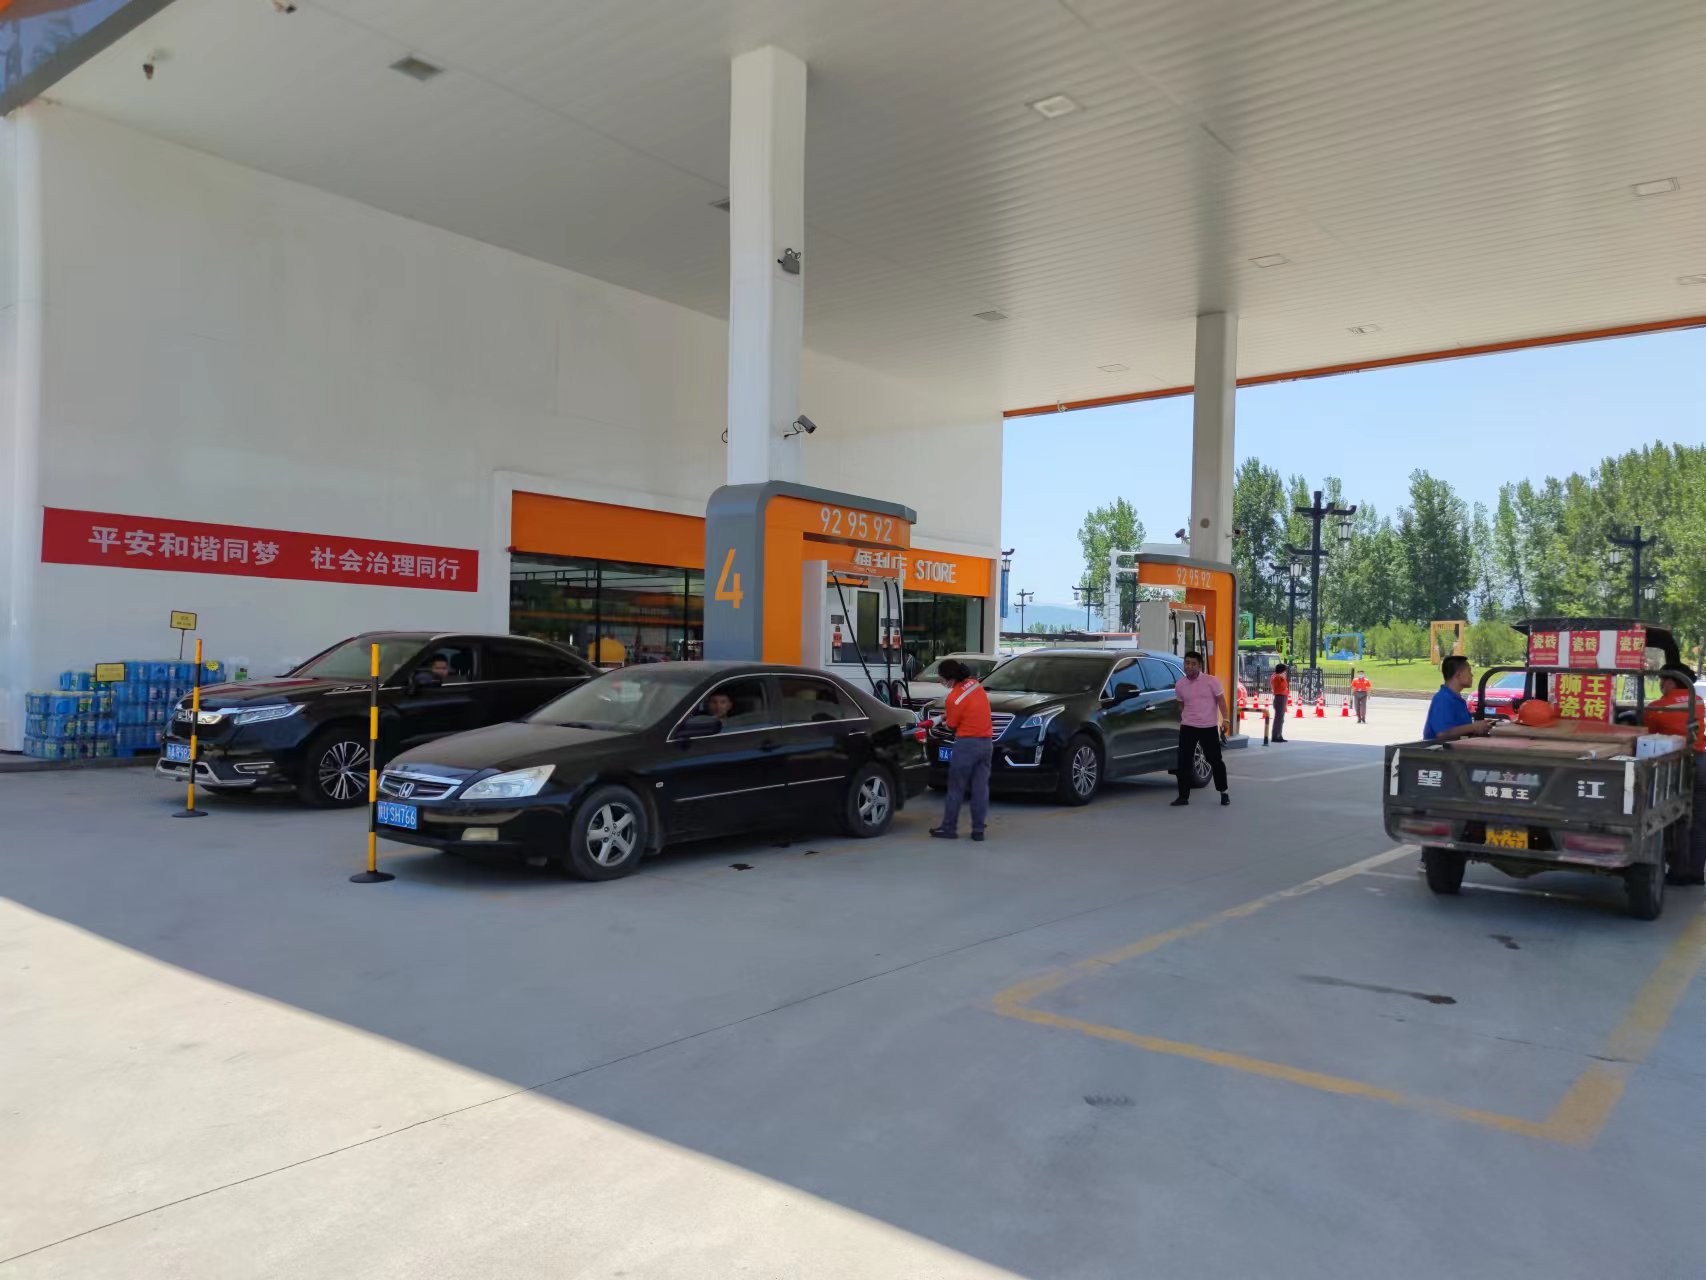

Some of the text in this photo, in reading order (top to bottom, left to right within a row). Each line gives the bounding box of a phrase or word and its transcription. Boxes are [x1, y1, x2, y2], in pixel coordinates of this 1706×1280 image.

[821, 507, 892, 542] 92 95 92
[88, 525, 461, 581] 平安和谐同梦 社会治理同行
[714, 548, 744, 609] 4
[916, 559, 957, 584] STORE
[1559, 674, 1607, 696] 狮王
[1560, 696, 1607, 720] 瓷砖
[1577, 780, 1605, 799] 江
